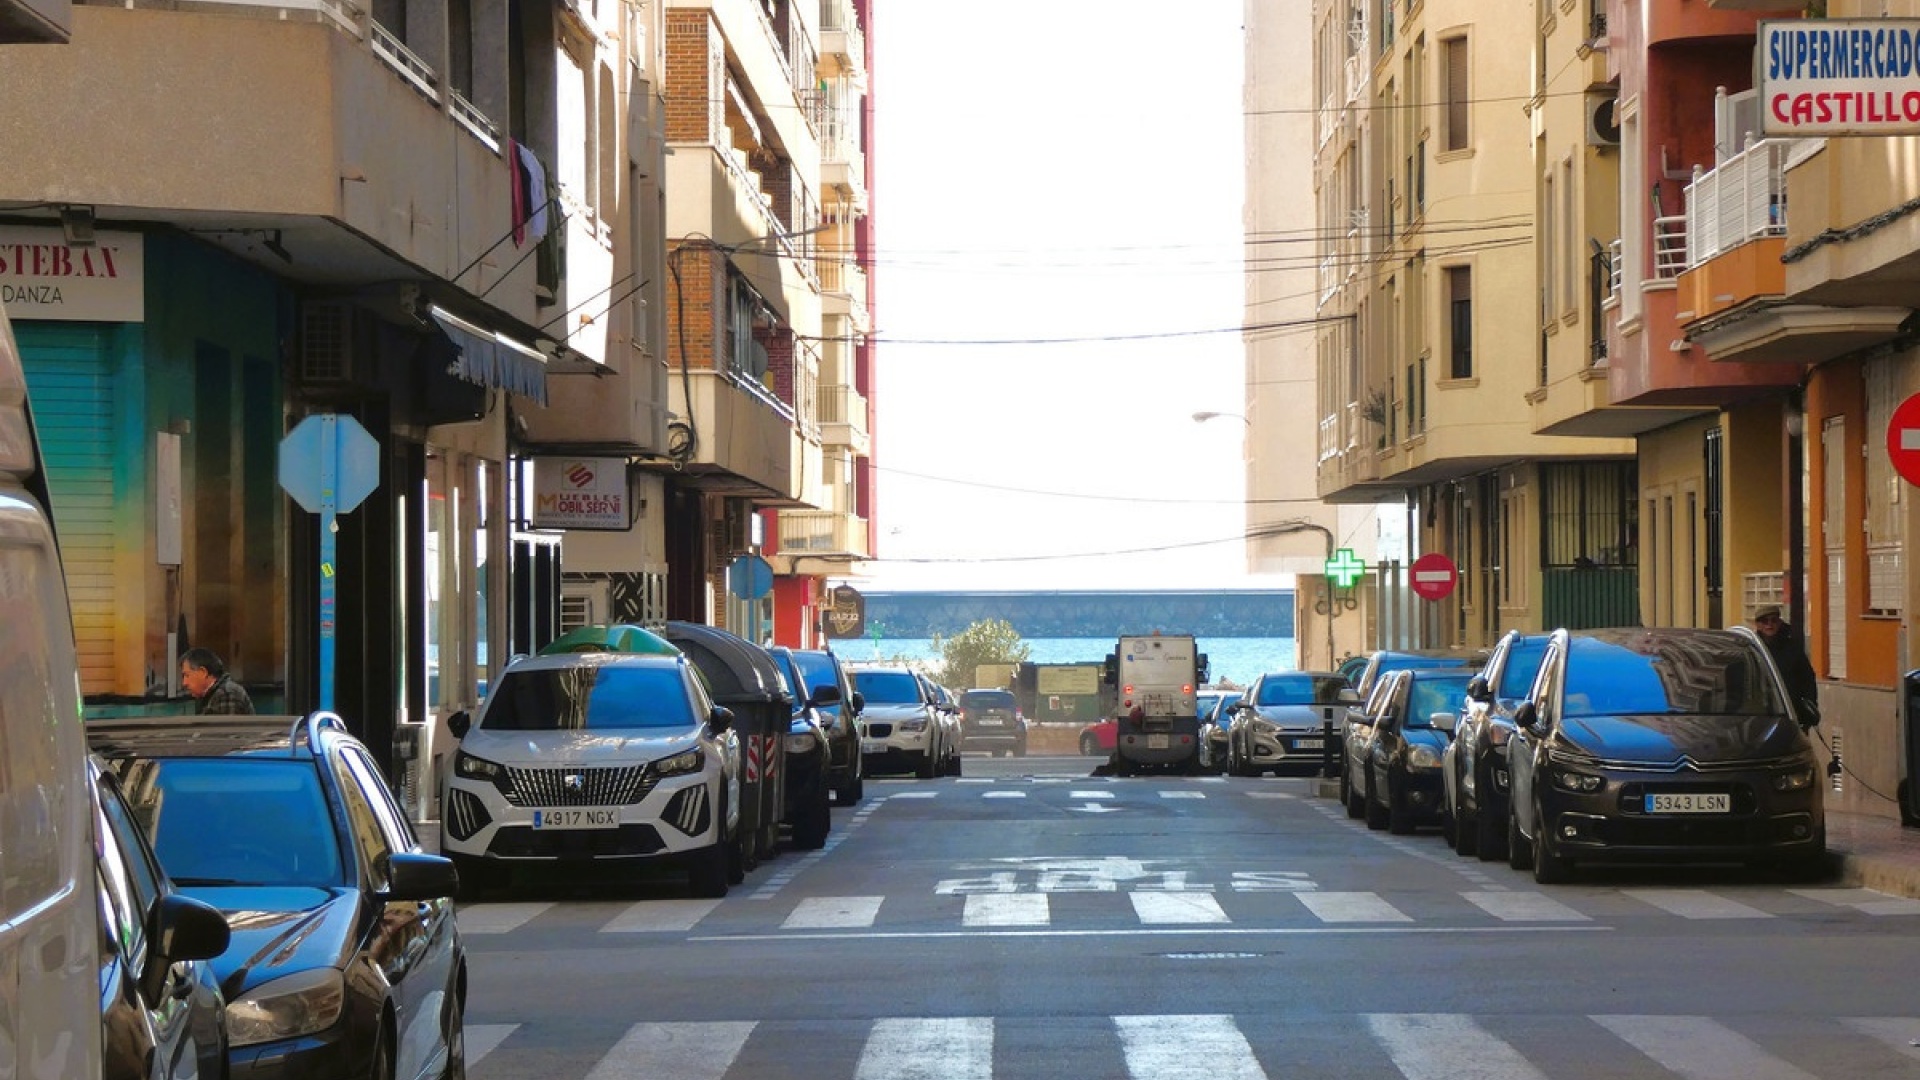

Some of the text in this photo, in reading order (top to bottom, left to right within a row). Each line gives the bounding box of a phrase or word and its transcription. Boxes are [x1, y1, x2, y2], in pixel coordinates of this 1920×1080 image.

[1772, 90, 1920, 127] CASTILLO
[2, 285, 63, 304] DANZA
[1655, 796, 1726, 810] 5343 LSN
[544, 811, 614, 825] 4917 NGX
